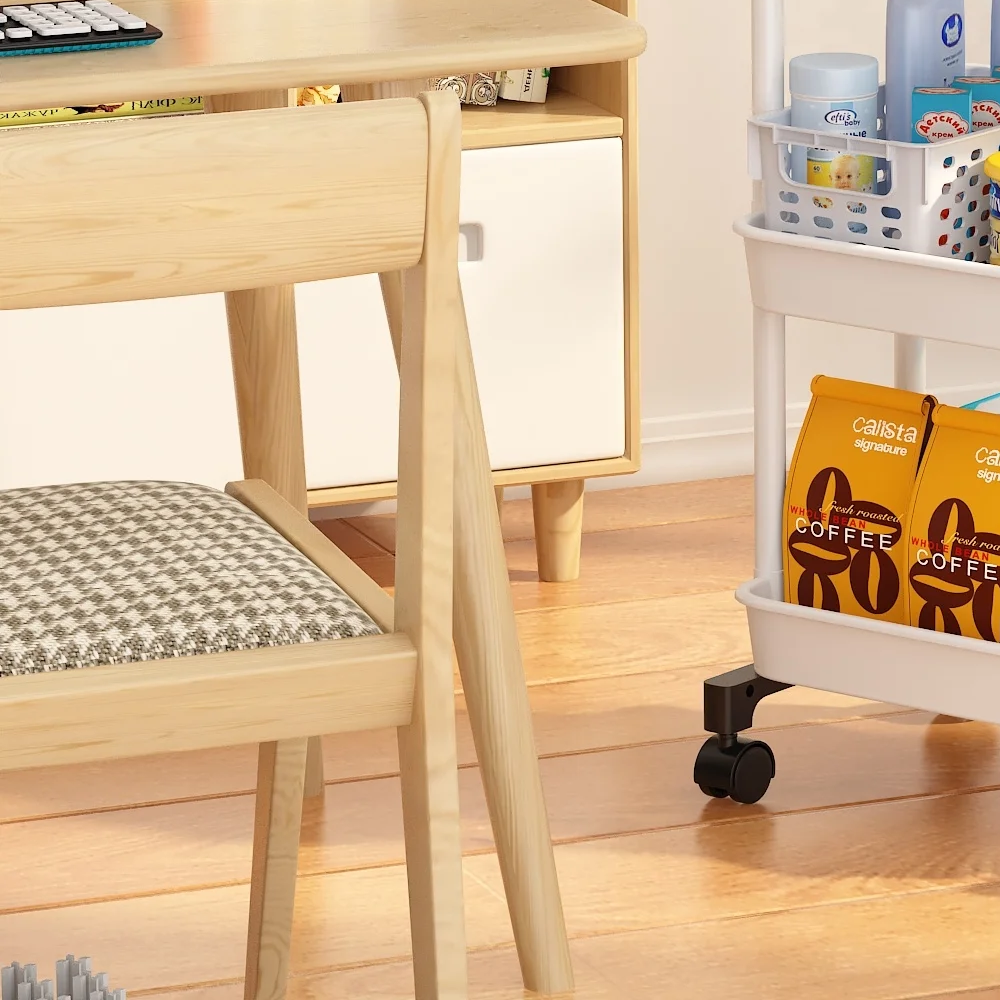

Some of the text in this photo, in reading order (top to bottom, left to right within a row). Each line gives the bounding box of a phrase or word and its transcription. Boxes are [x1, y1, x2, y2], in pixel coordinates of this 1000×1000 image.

[920, 115, 966, 134] Детский
[852, 416, 917, 443] Calista
[854, 437, 908, 456] signature
[790, 504, 866, 530] WHOLE BEAN
[819, 501, 904, 524] fresh roasted
[795, 517, 893, 551] COFFEE
[941, 532, 978, 548] fresh
[911, 536, 990, 561] WHOLE BEAN
